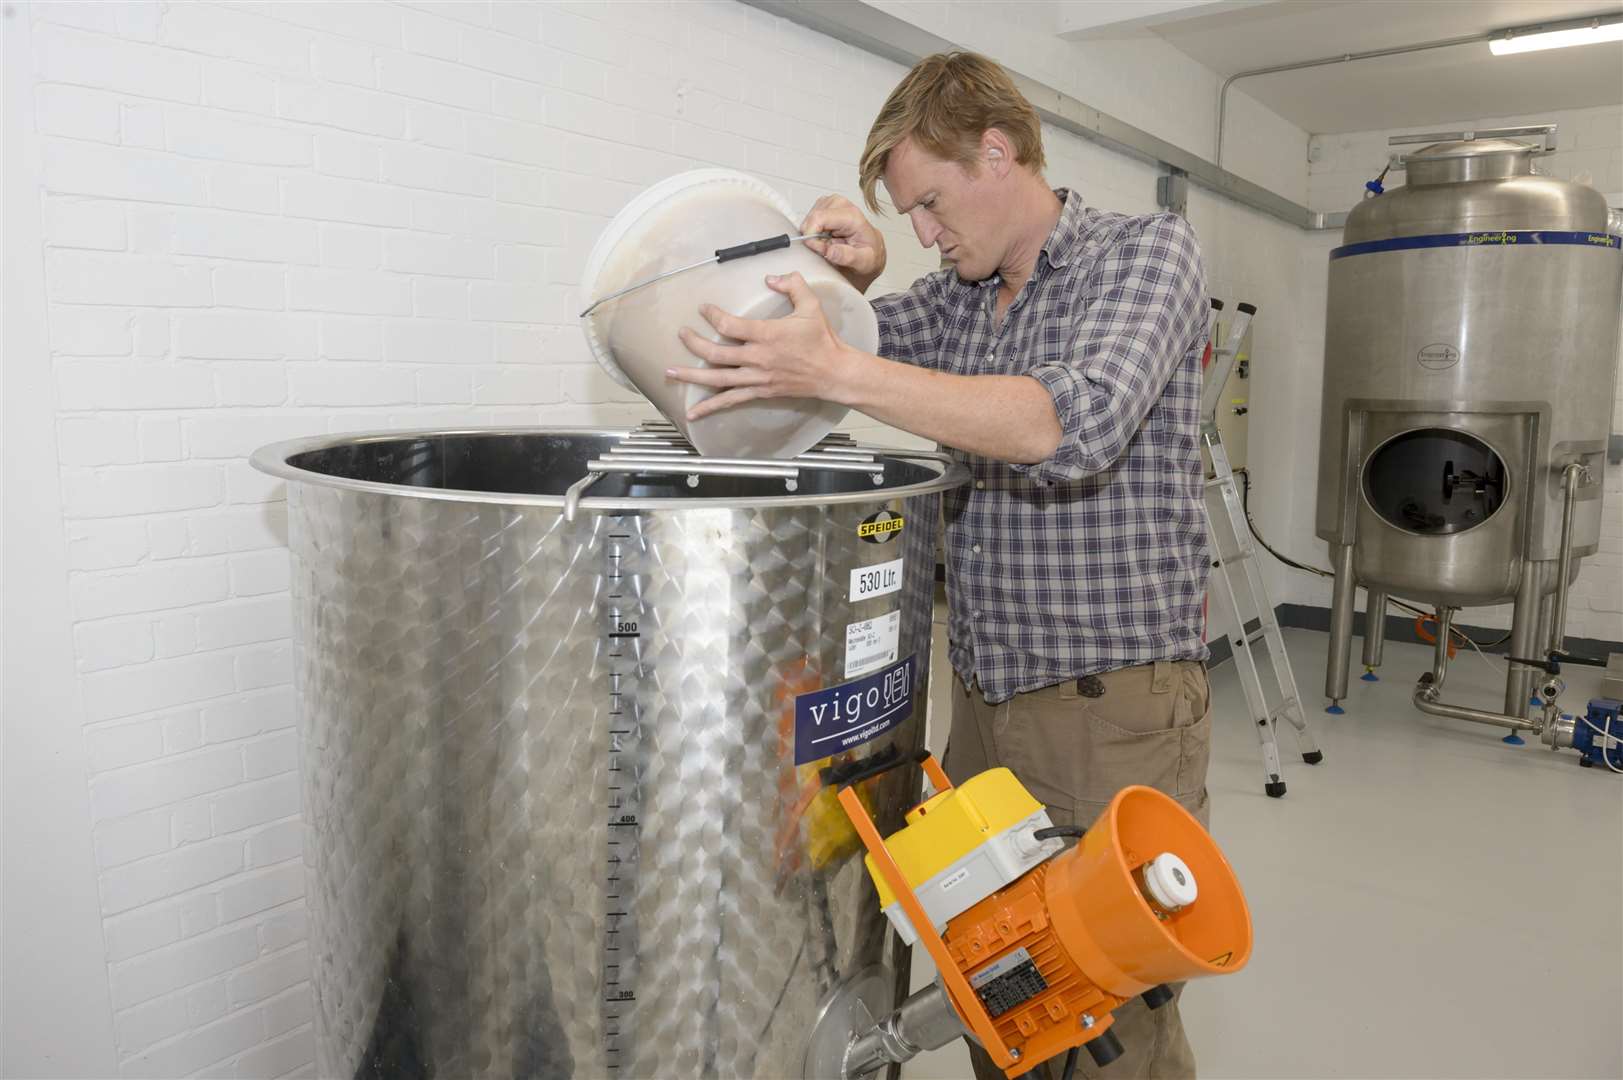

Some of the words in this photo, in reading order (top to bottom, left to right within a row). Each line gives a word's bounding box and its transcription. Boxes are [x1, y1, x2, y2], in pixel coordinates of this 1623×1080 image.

[861, 519, 902, 535] SPEIDEL
[859, 571, 881, 594] 530
[883, 569, 896, 588] Ltr.
[618, 622, 638, 632] 500
[809, 687, 879, 726] vigo
[842, 720, 891, 746] www.vigoltd.com
[620, 814, 636, 823] 400
[618, 990, 634, 999] 300
